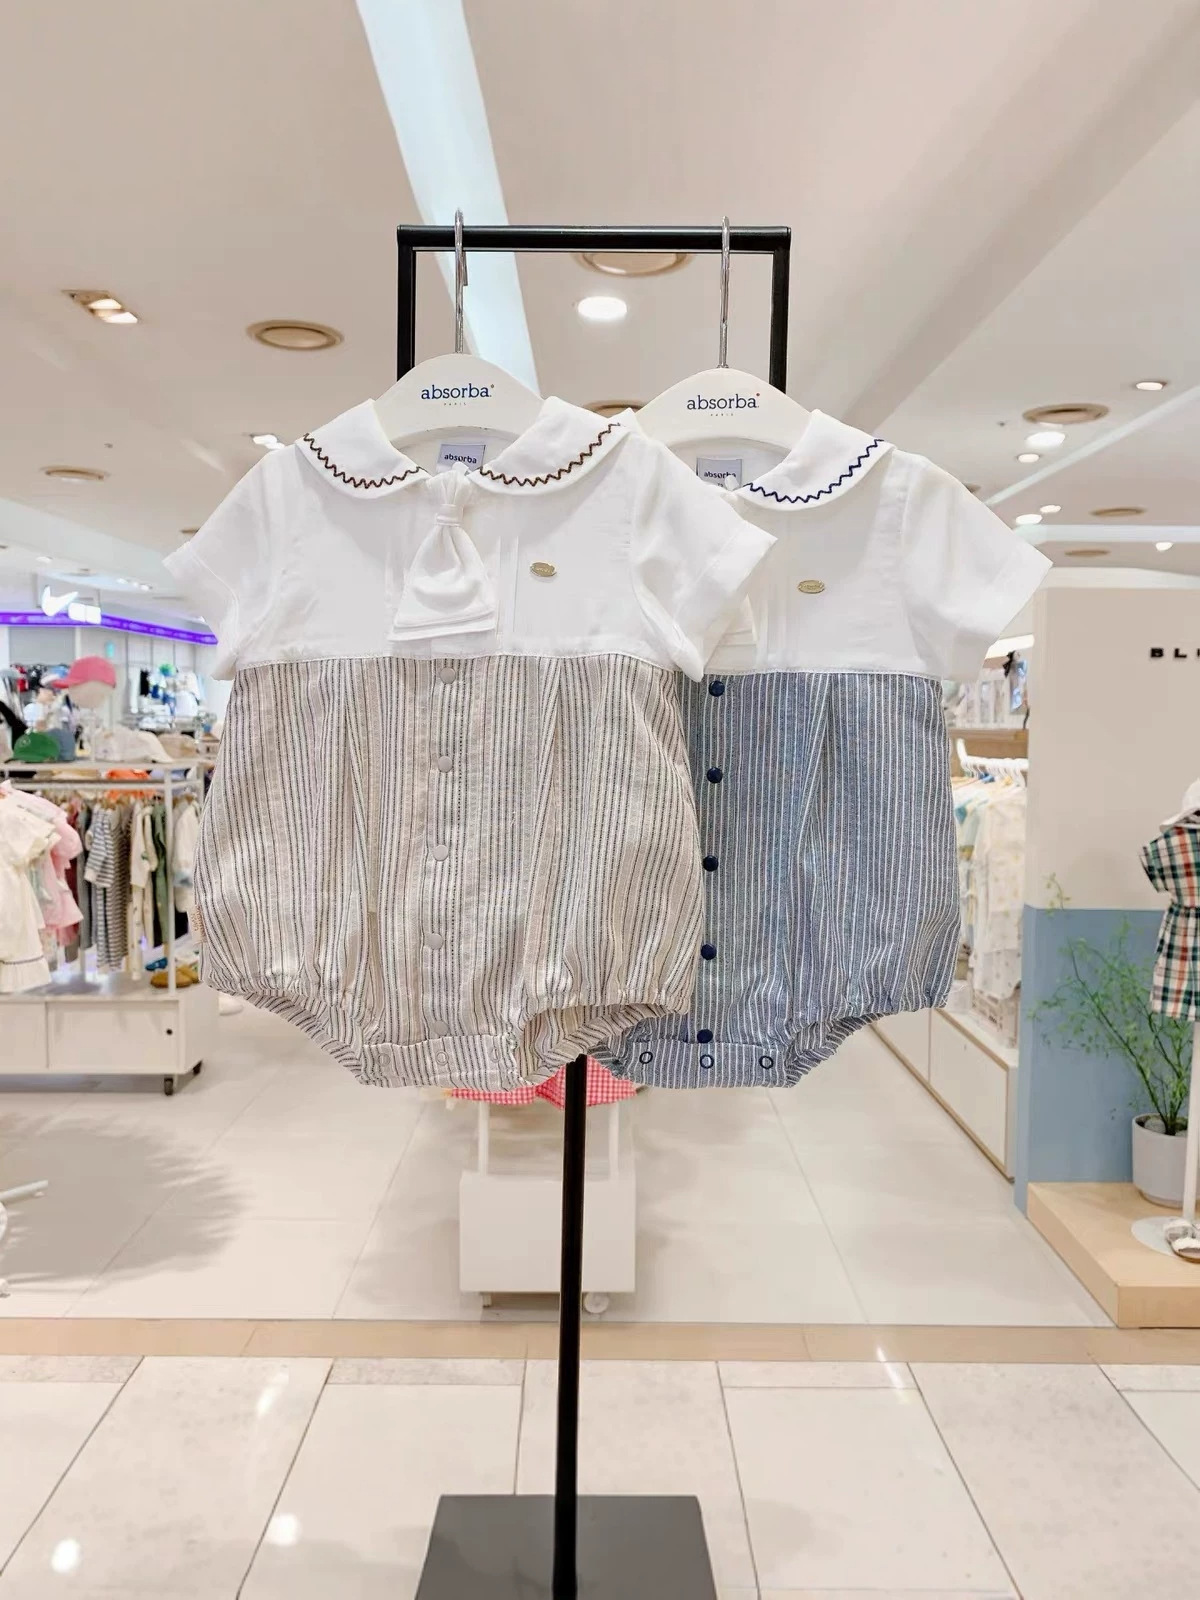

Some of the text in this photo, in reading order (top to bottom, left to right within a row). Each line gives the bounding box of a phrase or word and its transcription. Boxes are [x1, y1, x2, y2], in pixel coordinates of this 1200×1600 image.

[421, 383, 489, 399] absorba
[687, 393, 757, 410] absorba
[444, 453, 477, 464] absorba
